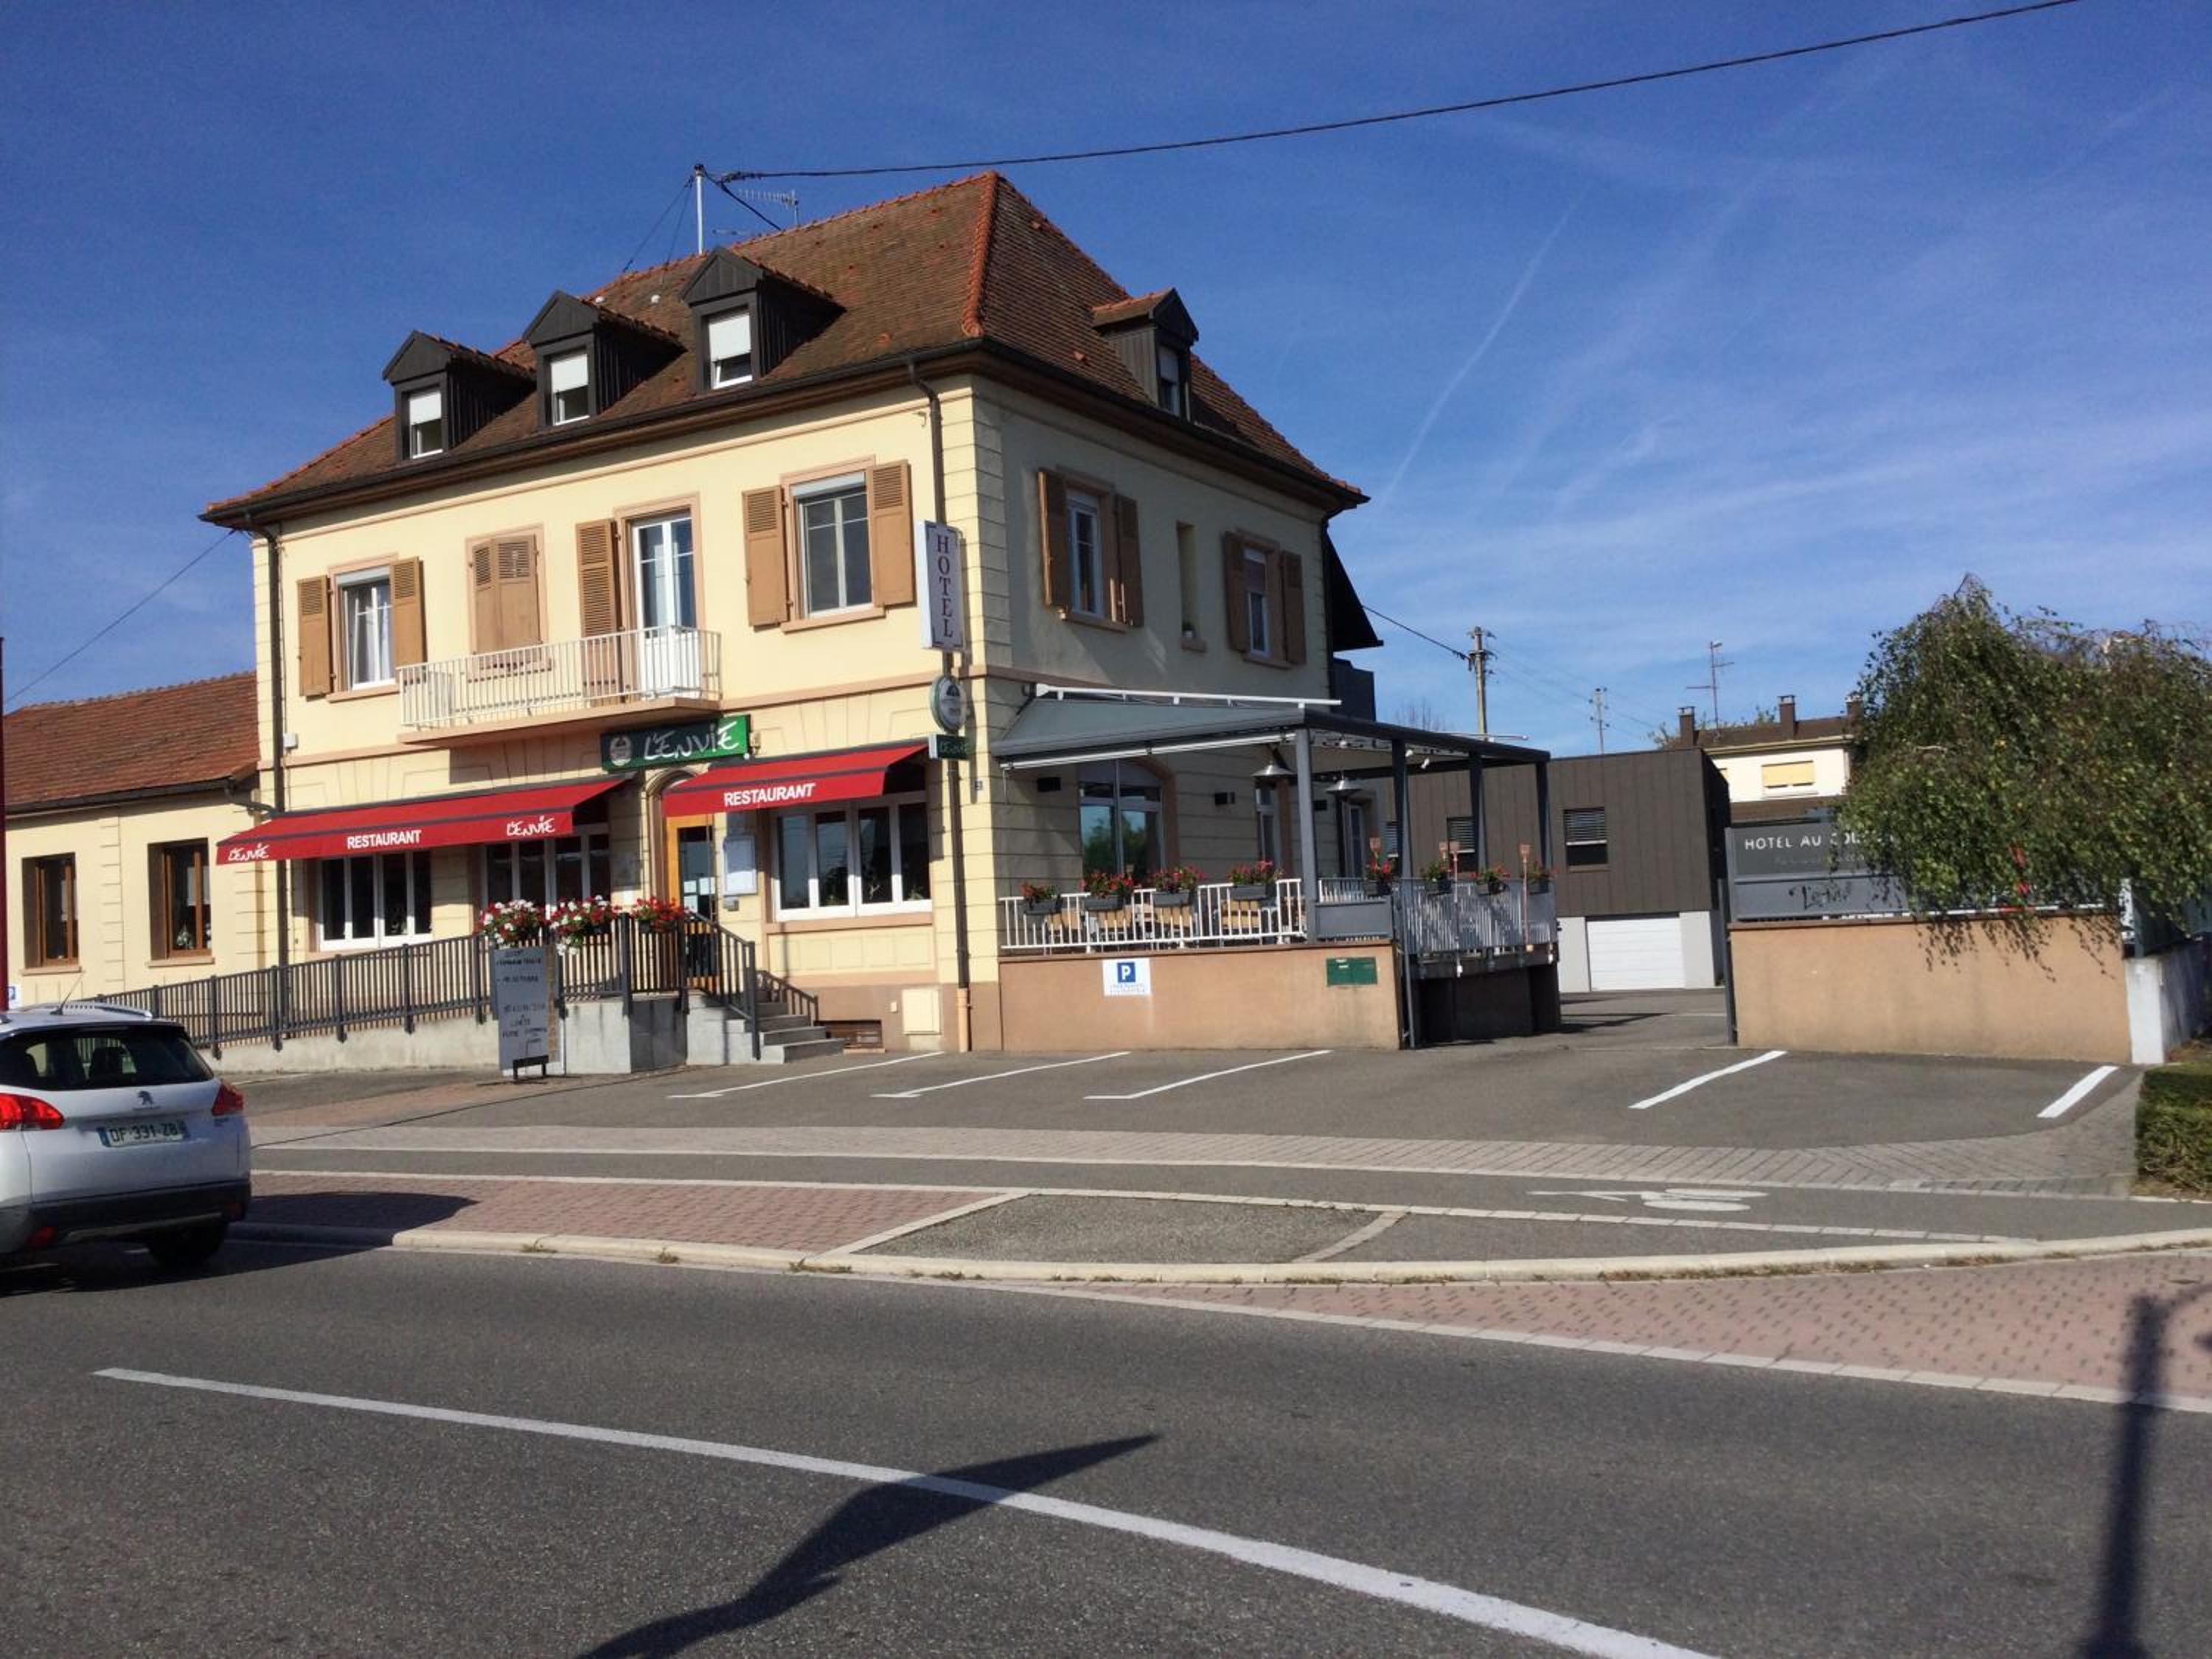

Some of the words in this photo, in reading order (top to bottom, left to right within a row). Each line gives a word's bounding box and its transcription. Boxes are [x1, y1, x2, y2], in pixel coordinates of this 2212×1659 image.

[937, 535, 953, 639] HOTEL
[724, 782, 816, 807] RESTAURANT
[347, 830, 422, 849] RESTAURANT
[1745, 836, 1794, 850] HOTEL
[1800, 835, 1822, 848] AU
[1121, 964, 1132, 981] P
